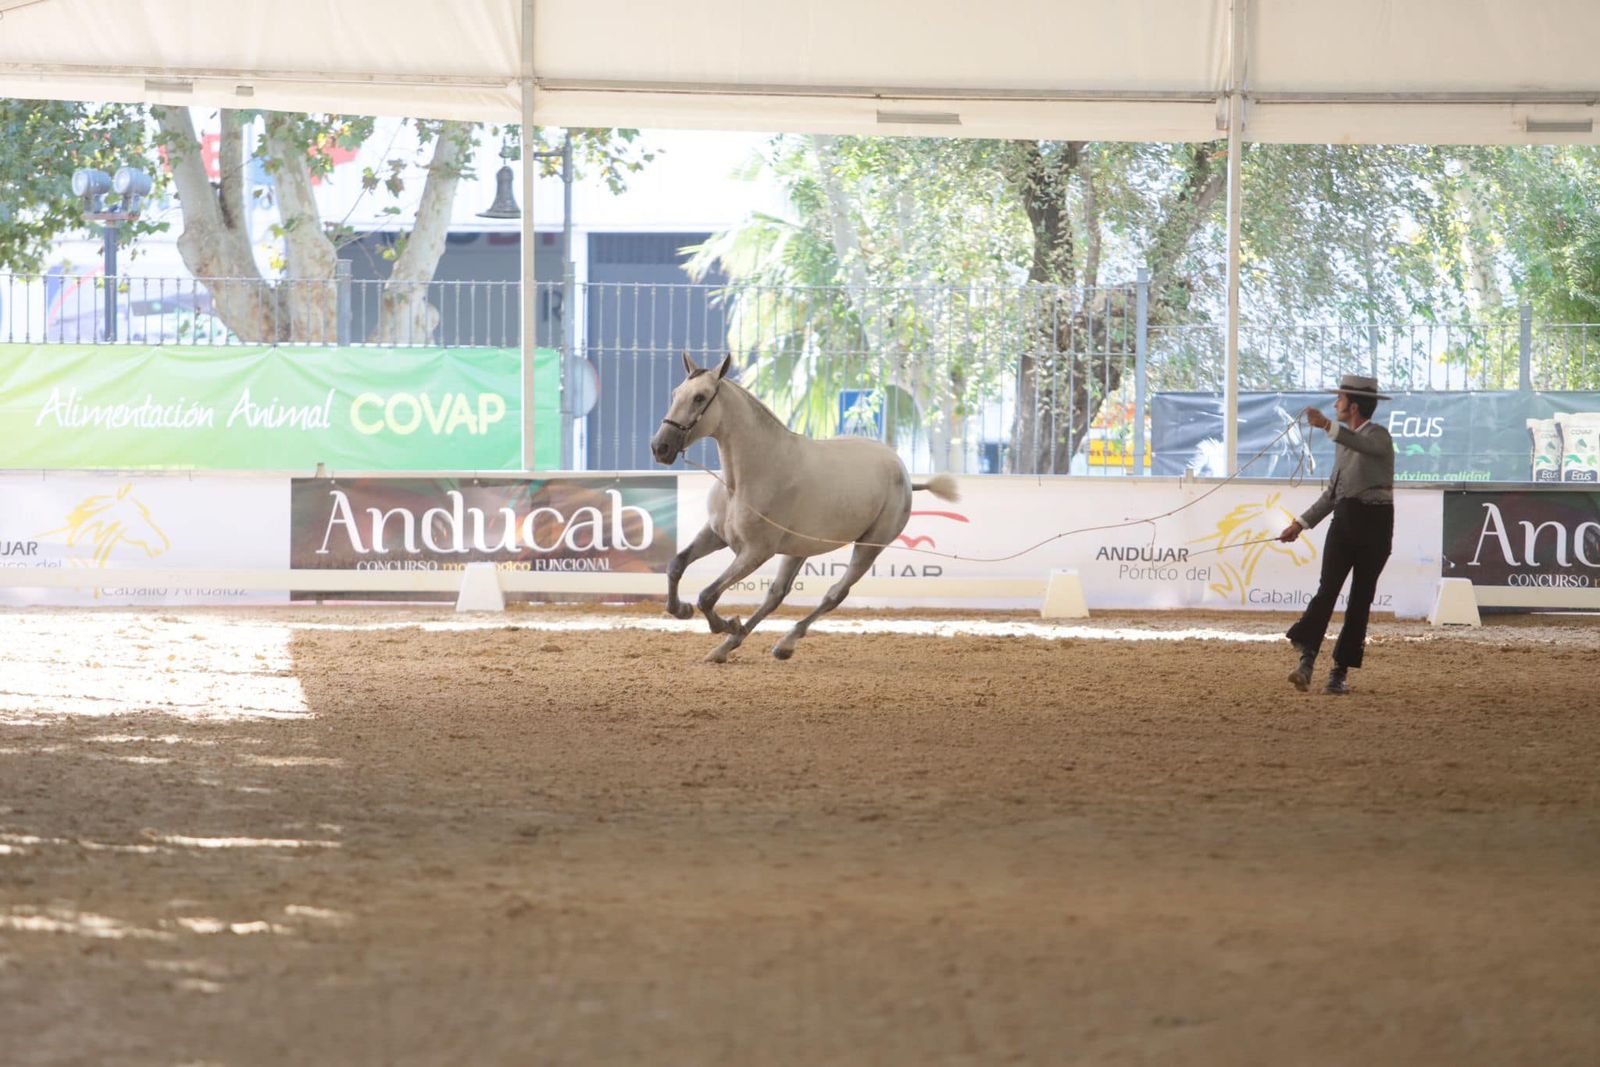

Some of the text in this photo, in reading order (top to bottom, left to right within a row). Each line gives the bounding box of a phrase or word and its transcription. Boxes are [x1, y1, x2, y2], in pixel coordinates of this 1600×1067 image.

[35, 387, 336, 430] Alimentación Animal
[350, 392, 506, 435] COVAP
[1388, 411, 1444, 438] Ecus
[316, 489, 654, 554] Anducab
[357, 560, 438, 571] CONCURSO
[535, 557, 612, 571] FUNCIONAL
[1096, 543, 1189, 562] ANDÚJAR
[1119, 564, 1212, 581] Pórtico del
[1508, 573, 1589, 587] CONCURSO
